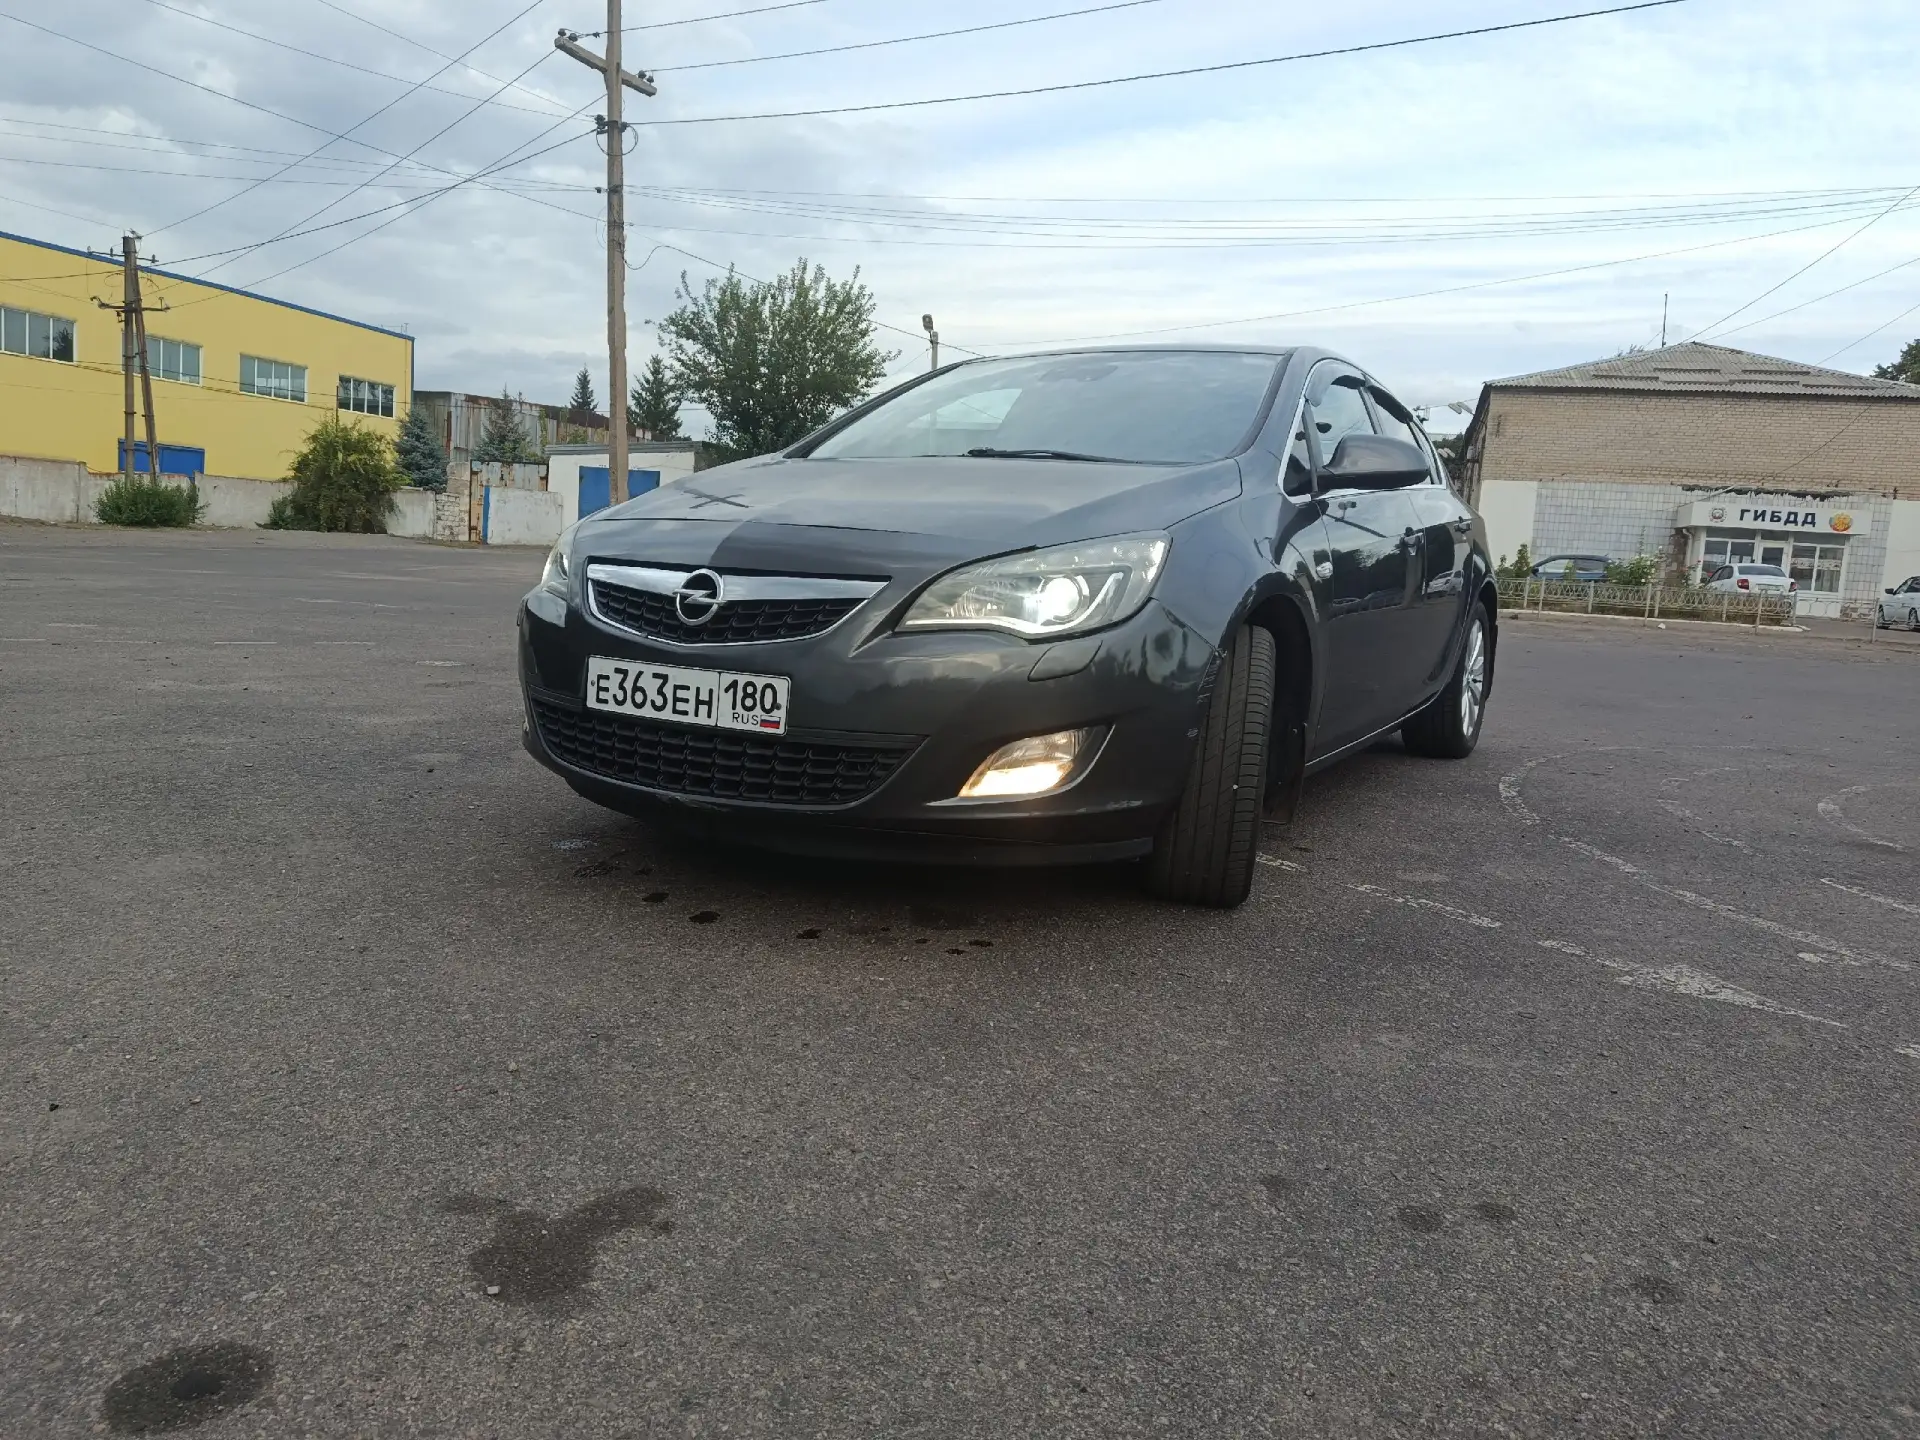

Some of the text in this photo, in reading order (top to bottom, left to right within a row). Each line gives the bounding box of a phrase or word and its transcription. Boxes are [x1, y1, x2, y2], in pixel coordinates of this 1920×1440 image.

[1739, 508, 1816, 527] ГИБДД
[595, 667, 778, 719] Е363ЕН 180
[732, 712, 759, 726] RUS
